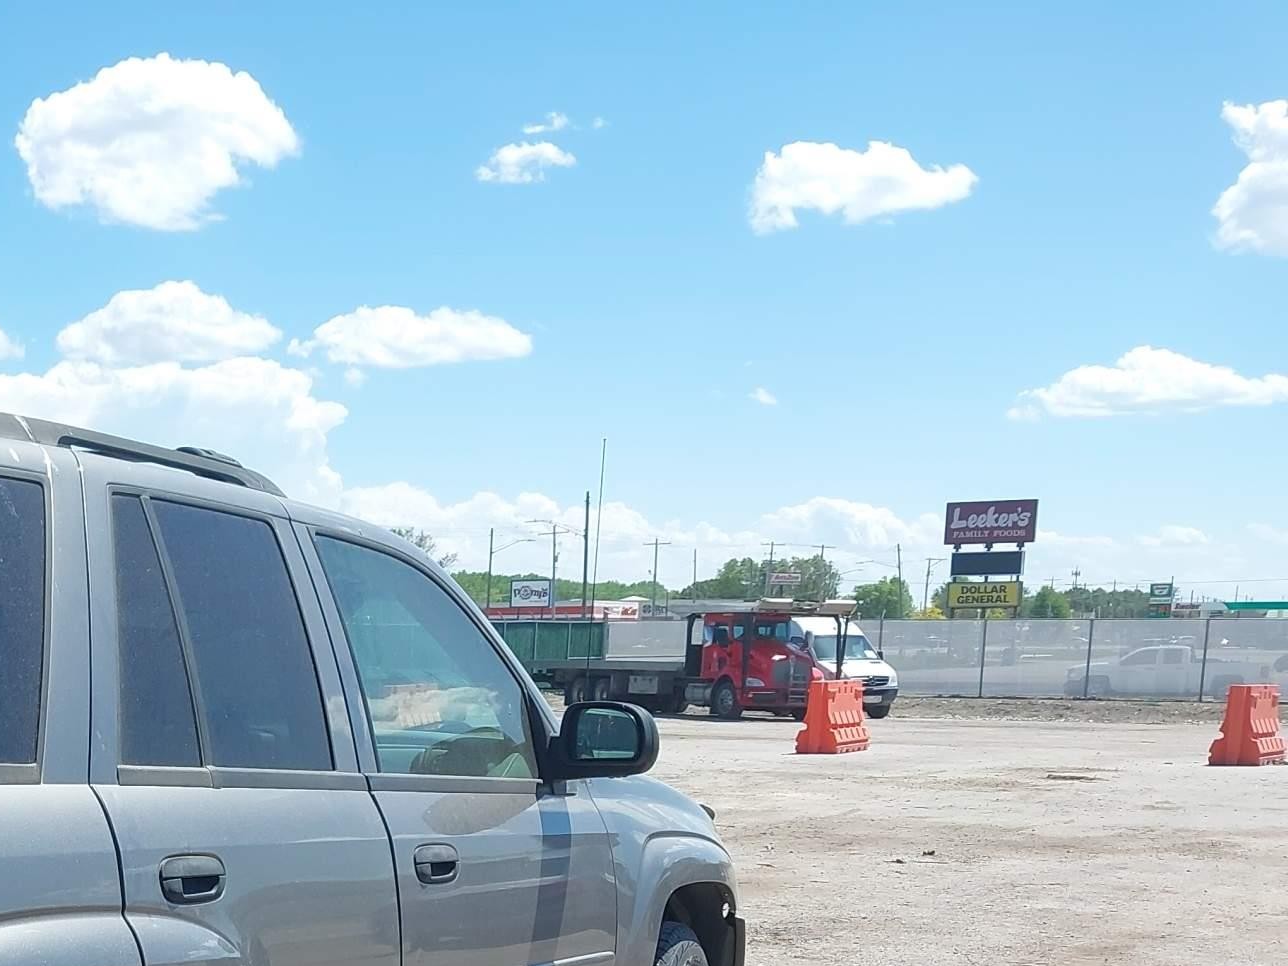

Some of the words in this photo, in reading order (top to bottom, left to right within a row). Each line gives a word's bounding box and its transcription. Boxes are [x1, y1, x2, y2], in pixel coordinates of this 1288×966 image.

[951, 506, 1032, 529] Leeker's
[953, 530, 989, 538] FAMILY
[993, 529, 1026, 537] FOODS
[961, 585, 1007, 594] DOLLAR
[957, 595, 1009, 604] GENERAL
